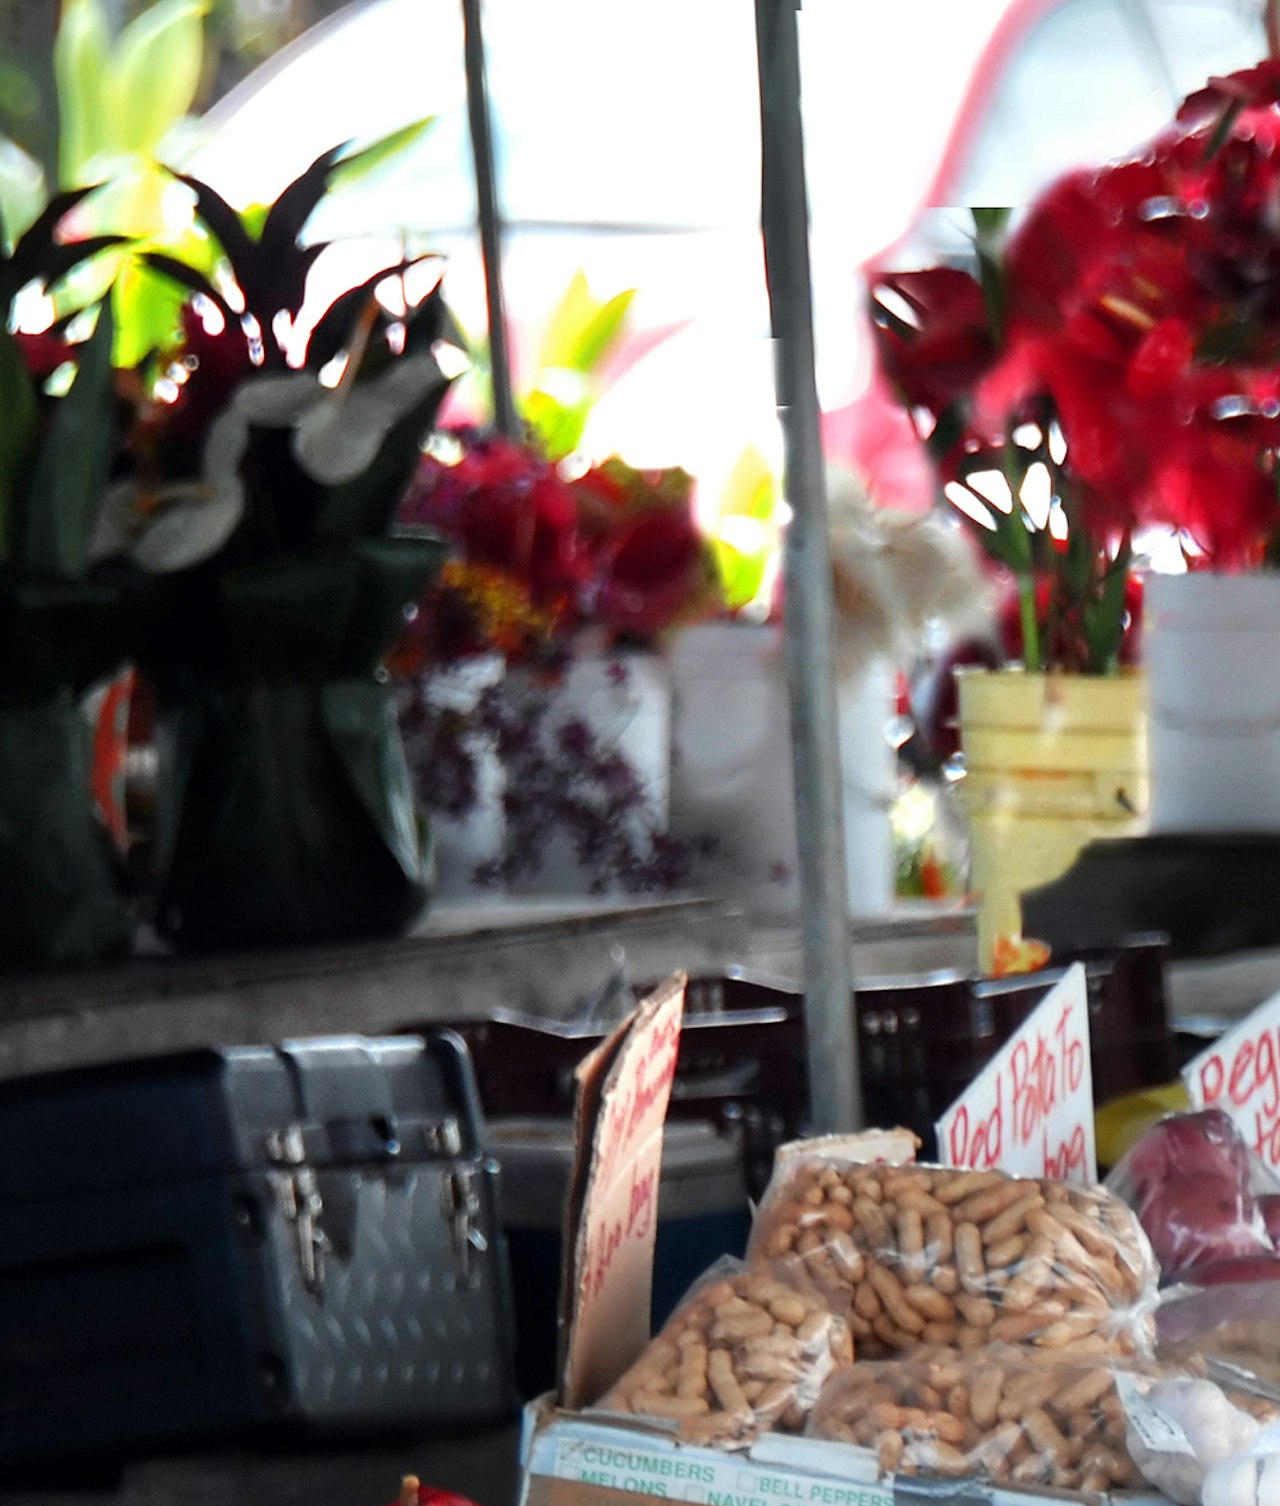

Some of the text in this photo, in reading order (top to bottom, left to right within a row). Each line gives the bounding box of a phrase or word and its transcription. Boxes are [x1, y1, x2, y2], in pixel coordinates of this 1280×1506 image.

[583, 1446, 716, 1484] CUCUMBERS
[580, 1468, 668, 1498] MELONS
[759, 1476, 804, 1501] BELL
